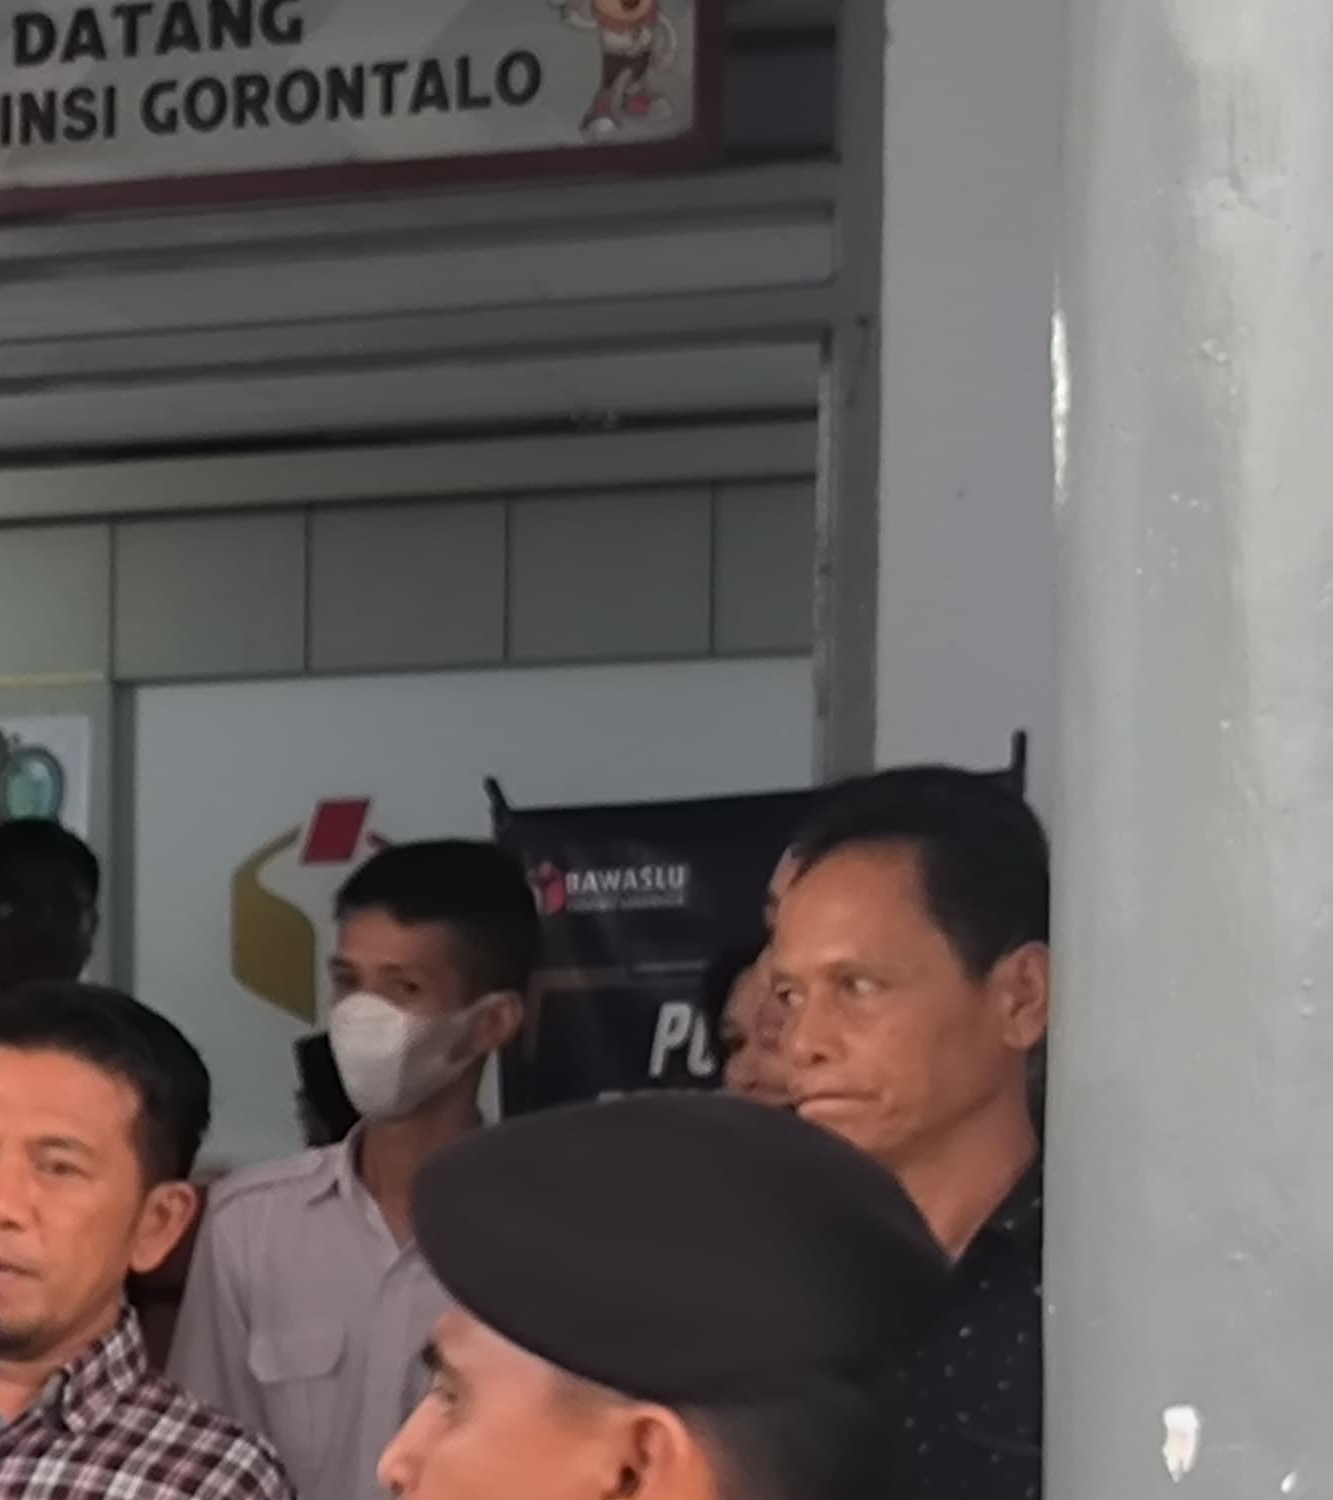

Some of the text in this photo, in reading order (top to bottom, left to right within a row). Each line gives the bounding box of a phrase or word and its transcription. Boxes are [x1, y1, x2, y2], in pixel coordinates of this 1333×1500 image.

[13, 0, 305, 67] DATANG
[140, 50, 543, 136] GORONTALO
[565, 864, 687, 894] BAWASLU
